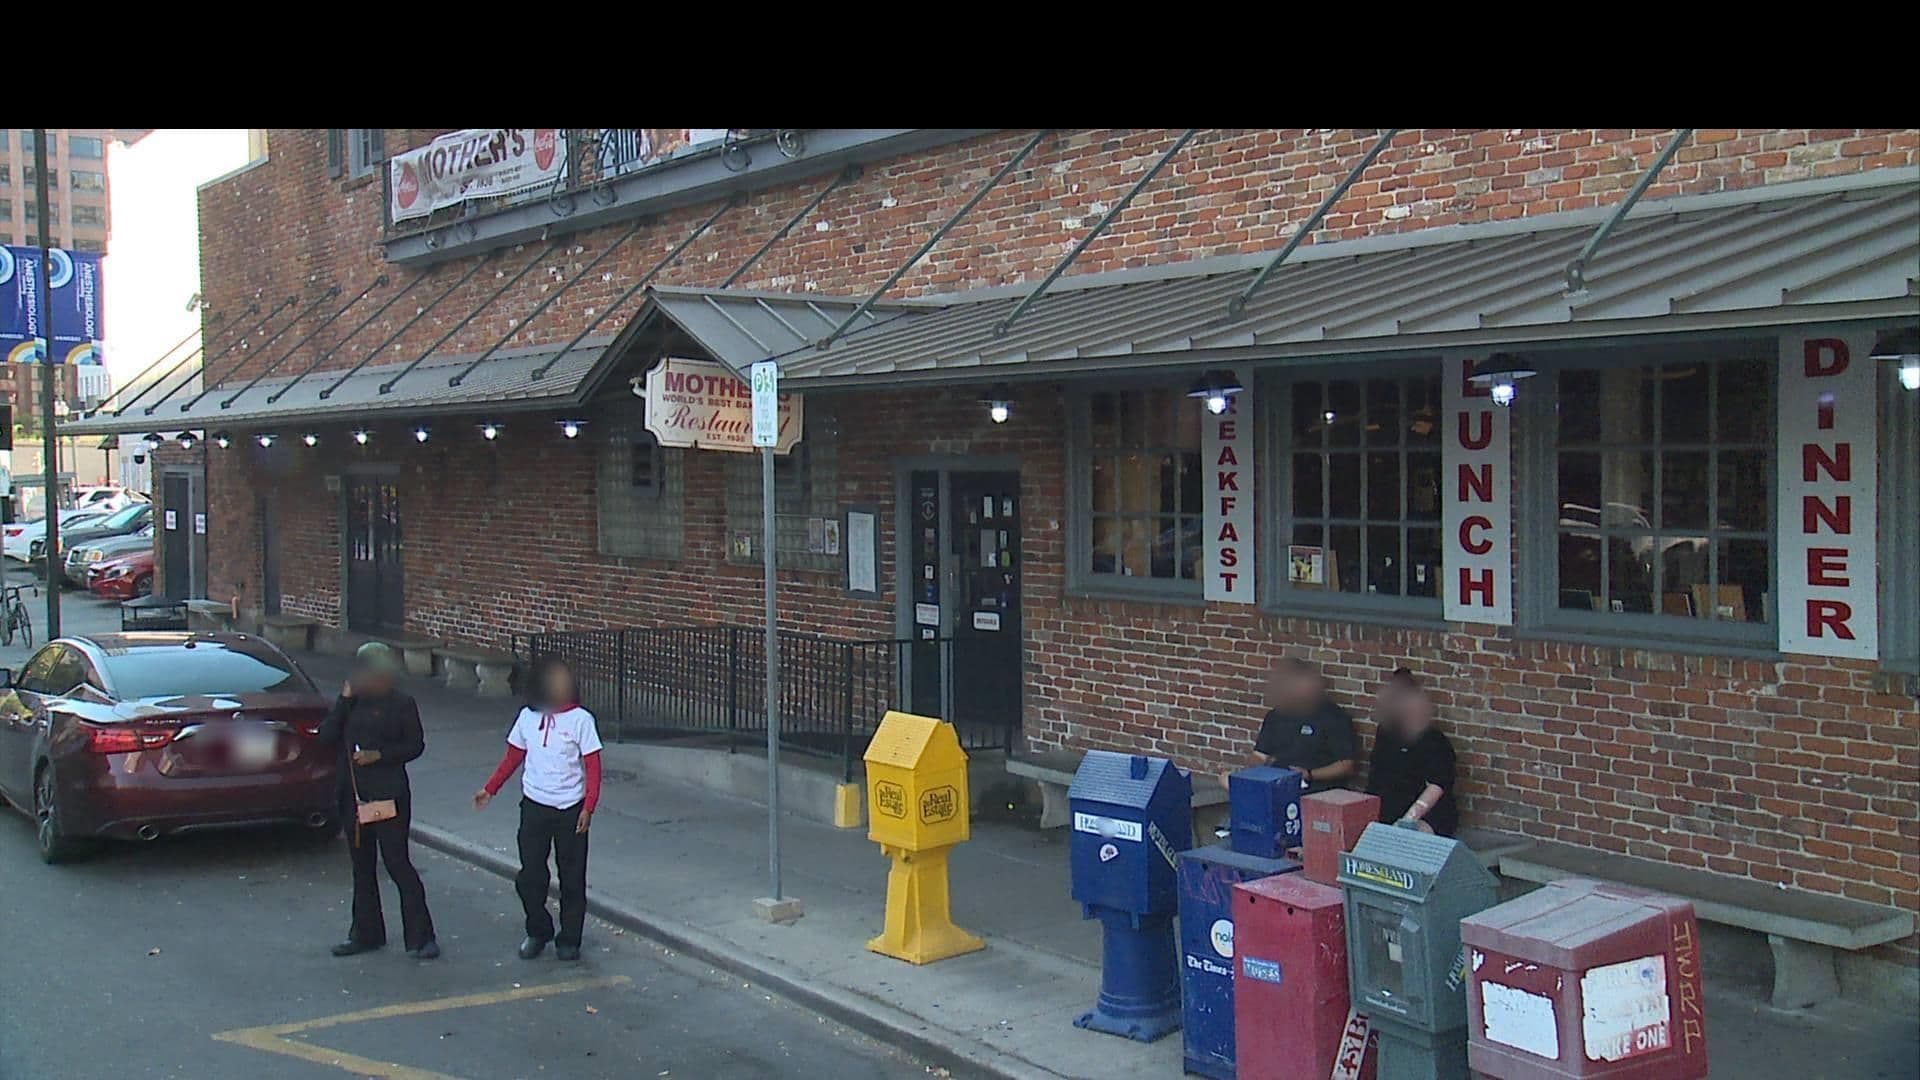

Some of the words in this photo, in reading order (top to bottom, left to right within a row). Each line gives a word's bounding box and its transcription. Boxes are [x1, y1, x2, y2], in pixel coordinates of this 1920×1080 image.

[418, 129, 525, 186] MOTHER'S
[662, 394, 703, 406] WORLD'S
[708, 399, 731, 408] BEST
[1802, 338, 1855, 640] DINNER
[1215, 931, 1234, 943] nol
[1187, 954, 1202, 970] The
[1636, 1026, 1666, 1050] ONE
